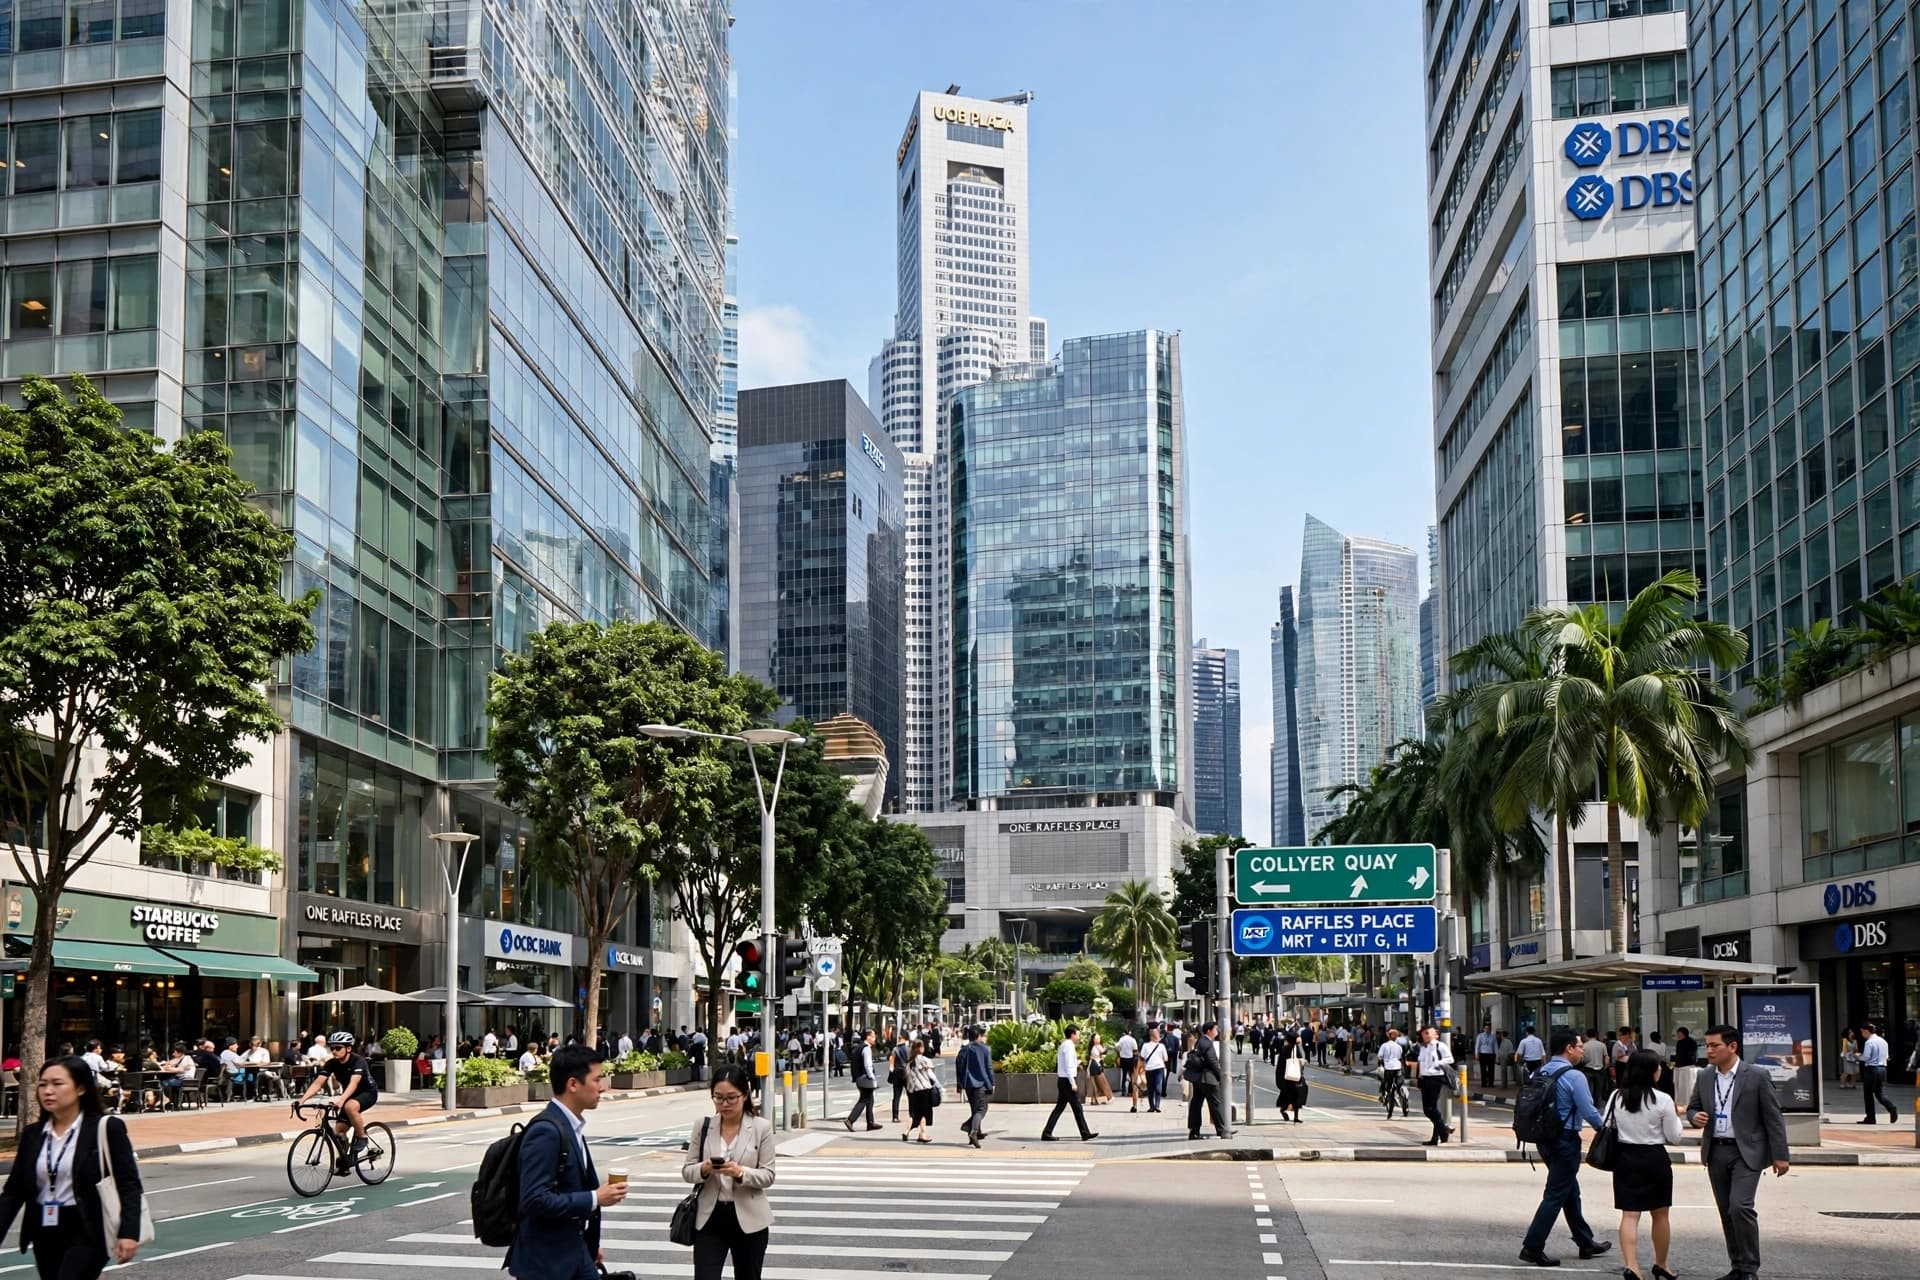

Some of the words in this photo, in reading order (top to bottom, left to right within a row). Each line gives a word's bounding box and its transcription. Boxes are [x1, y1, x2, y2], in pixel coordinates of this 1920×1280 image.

[934, 105, 966, 123] UOB
[970, 111, 1014, 132] PLAZA
[1616, 117, 1690, 158] DBS
[1619, 170, 1693, 211] DBS
[1010, 823, 1031, 833] ONE
[1036, 822, 1081, 832] RAFFLES
[1086, 820, 1119, 830] PLACE
[1250, 856, 1335, 873] COLLYER
[1345, 854, 1397, 871] QUAY
[1842, 880, 1876, 908] DBS
[132, 905, 219, 929] STARBUCKS
[306, 905, 329, 921] ONE
[332, 908, 372, 927] RAFFLES
[374, 914, 402, 931] PLACE
[1281, 915, 1354, 930] RAFFLES
[1361, 914, 1415, 929] PLACE
[146, 924, 201, 943] COFFEE
[514, 934, 538, 952] OCBC
[539, 938, 562, 957] BANK
[1281, 934, 1314, 948] MRT
[1334, 933, 1368, 947] EXIT
[1375, 933, 1390, 949] G,
[1397, 933, 1408, 947] H
[1854, 921, 1887, 947] DBS
